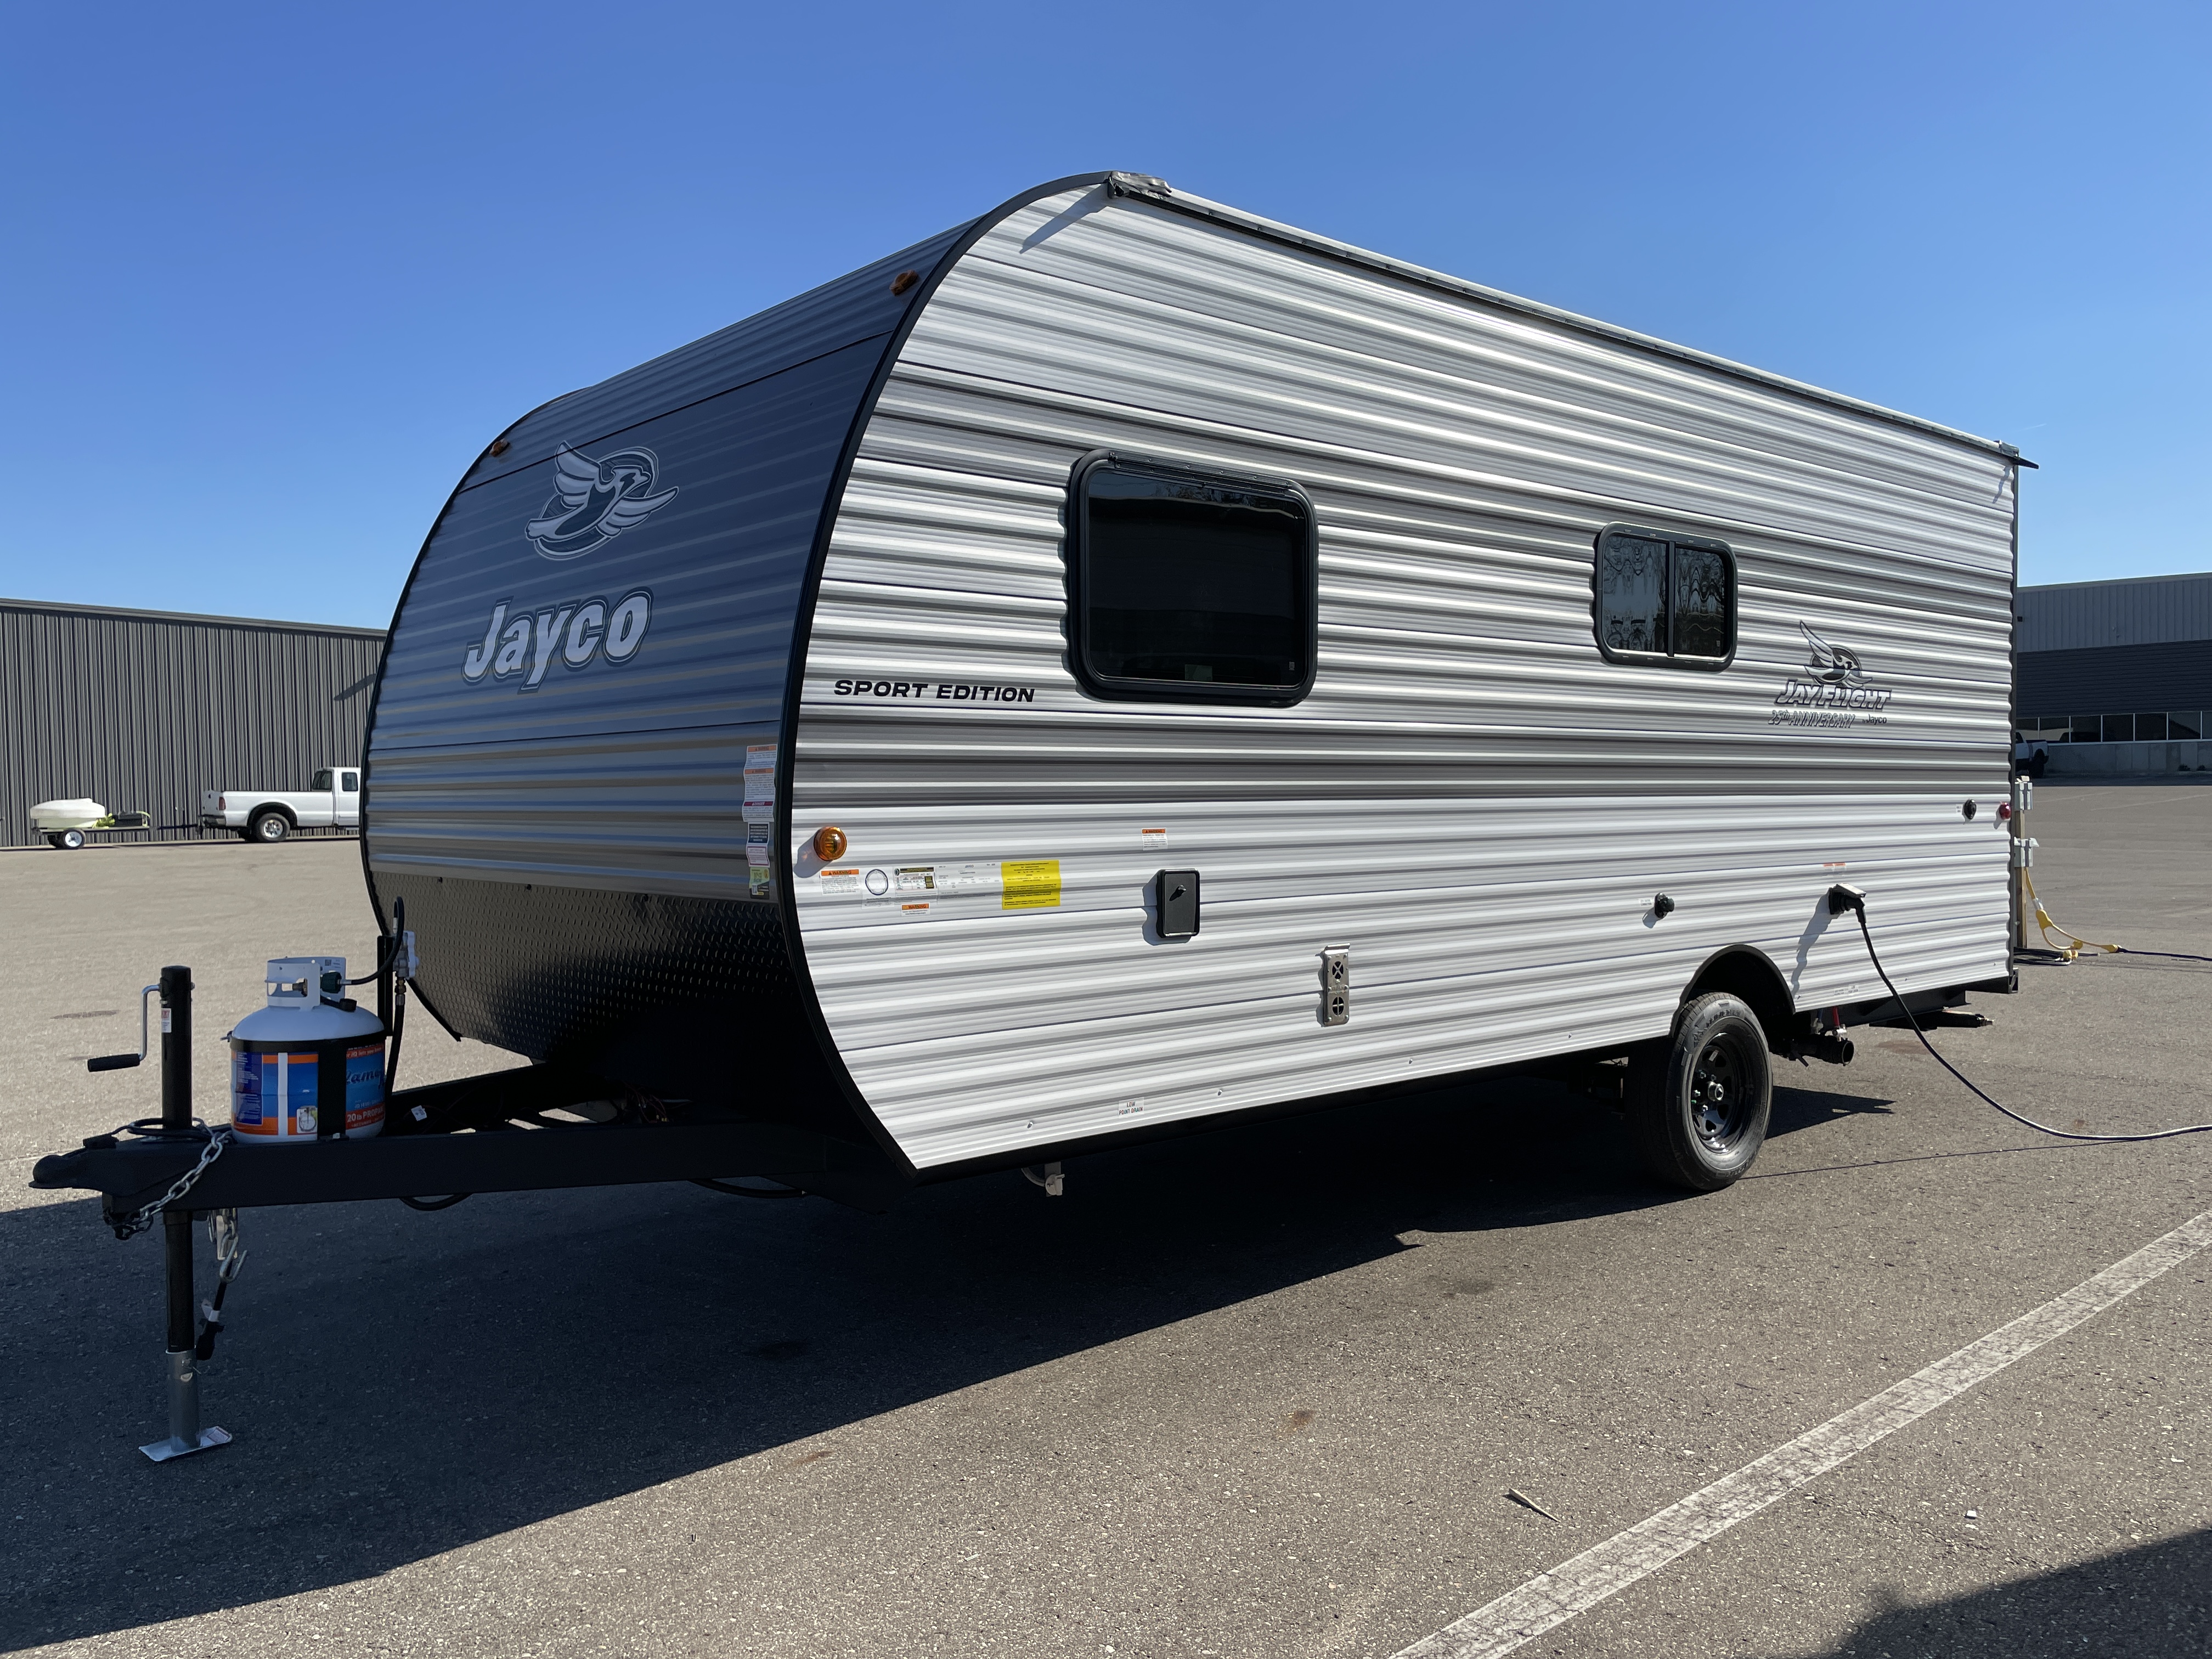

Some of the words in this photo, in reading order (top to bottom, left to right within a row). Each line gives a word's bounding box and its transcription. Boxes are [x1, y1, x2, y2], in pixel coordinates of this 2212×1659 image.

[462, 588, 653, 693] Jayco
[833, 680, 928, 698] SPORT
[936, 684, 1035, 702] EDITION
[1768, 709, 1790, 725] 25th
[1788, 711, 1856, 728] ANNIVERSARY
[1866, 714, 1887, 725] Jayco
[347, 1113, 357, 1123] 20
